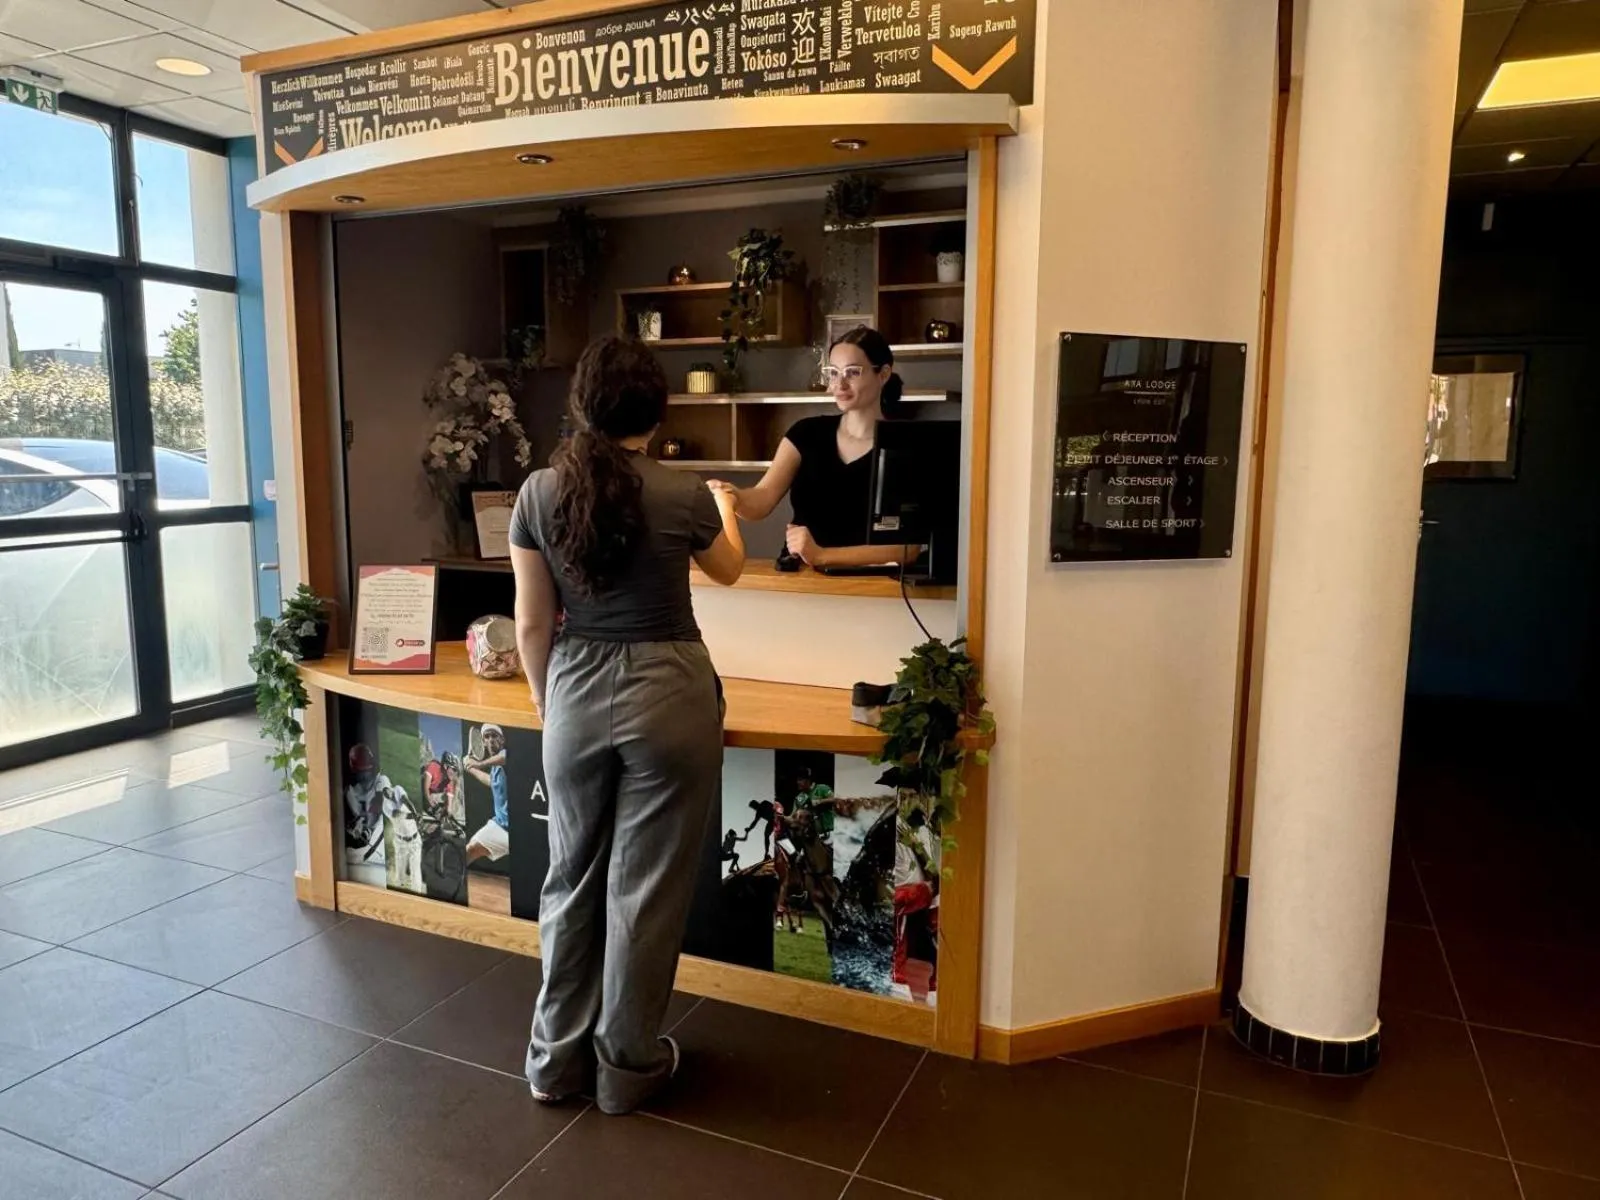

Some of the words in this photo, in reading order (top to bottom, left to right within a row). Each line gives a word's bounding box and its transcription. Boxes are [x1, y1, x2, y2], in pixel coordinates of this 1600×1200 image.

[741, 11, 786, 31] Swagata
[864, 2, 902, 24] Vítejte
[535, 29, 586, 49] Bonvenon
[741, 28, 785, 49] Ongietorri
[791, 7, 816, 65] 欢迎
[855, 20, 921, 45] Tervetuloa
[949, 23, 982, 39] Sugeng
[493, 27, 710, 105] Bienvenue
[741, 49, 787, 72] Yokôso
[875, 69, 921, 88] Swaagat
[656, 83, 709, 102] Bonavinuta
[379, 90, 431, 116] Velkomin
[1113, 430, 1177, 443] RÉCEPTION
[1104, 453, 1163, 465] DÉJEUNER
[1184, 454, 1218, 465] ÉTAGE
[1108, 477, 1174, 486] ASCENSEUR
[1107, 496, 1161, 505] ESCALIER
[1105, 520, 1139, 529] SALLE
[1142, 519, 1157, 528] DE
[1161, 518, 1197, 528] SPORT
